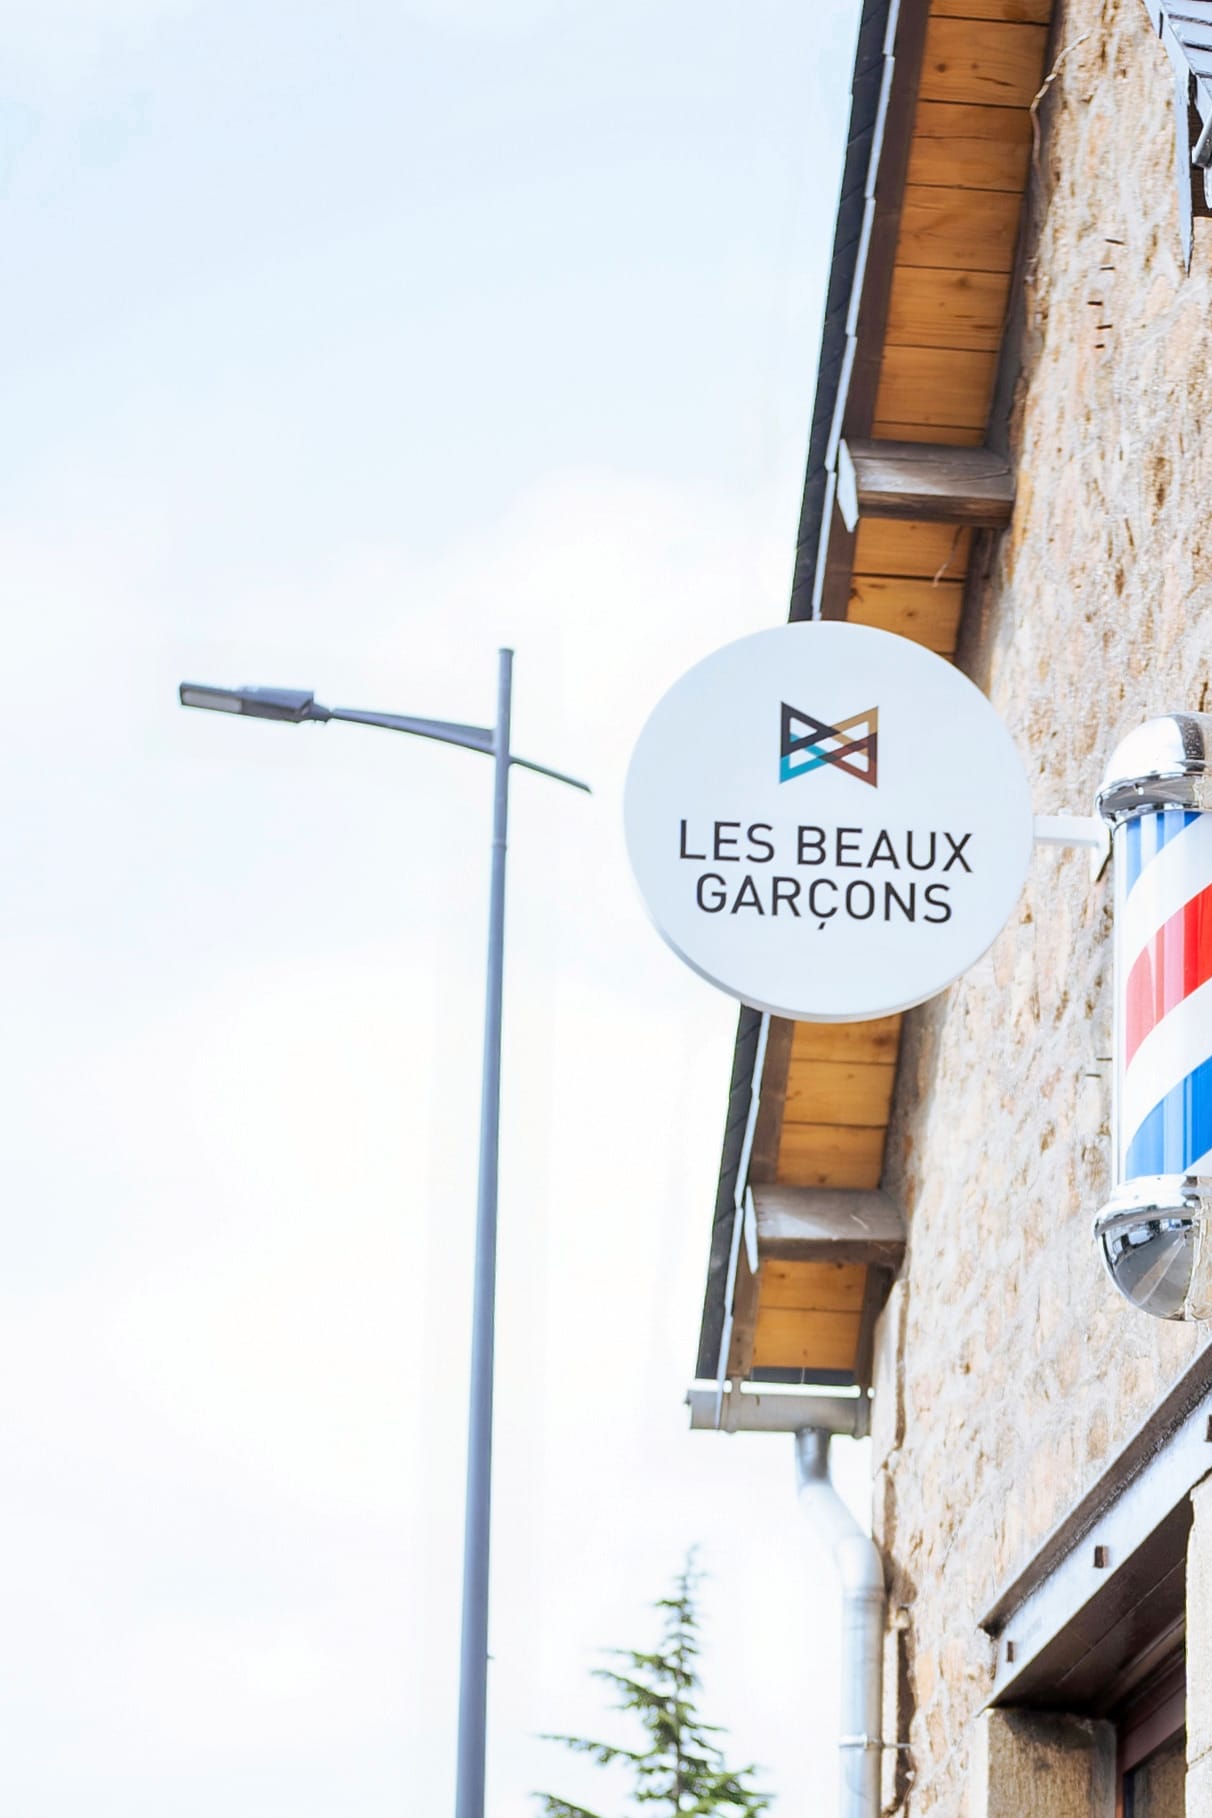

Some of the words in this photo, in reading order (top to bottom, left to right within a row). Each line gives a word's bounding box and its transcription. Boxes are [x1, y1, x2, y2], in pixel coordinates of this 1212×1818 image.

[679, 819, 775, 864] LES
[797, 825, 973, 873] BEAUX
[696, 872, 953, 930] GARÇONS
